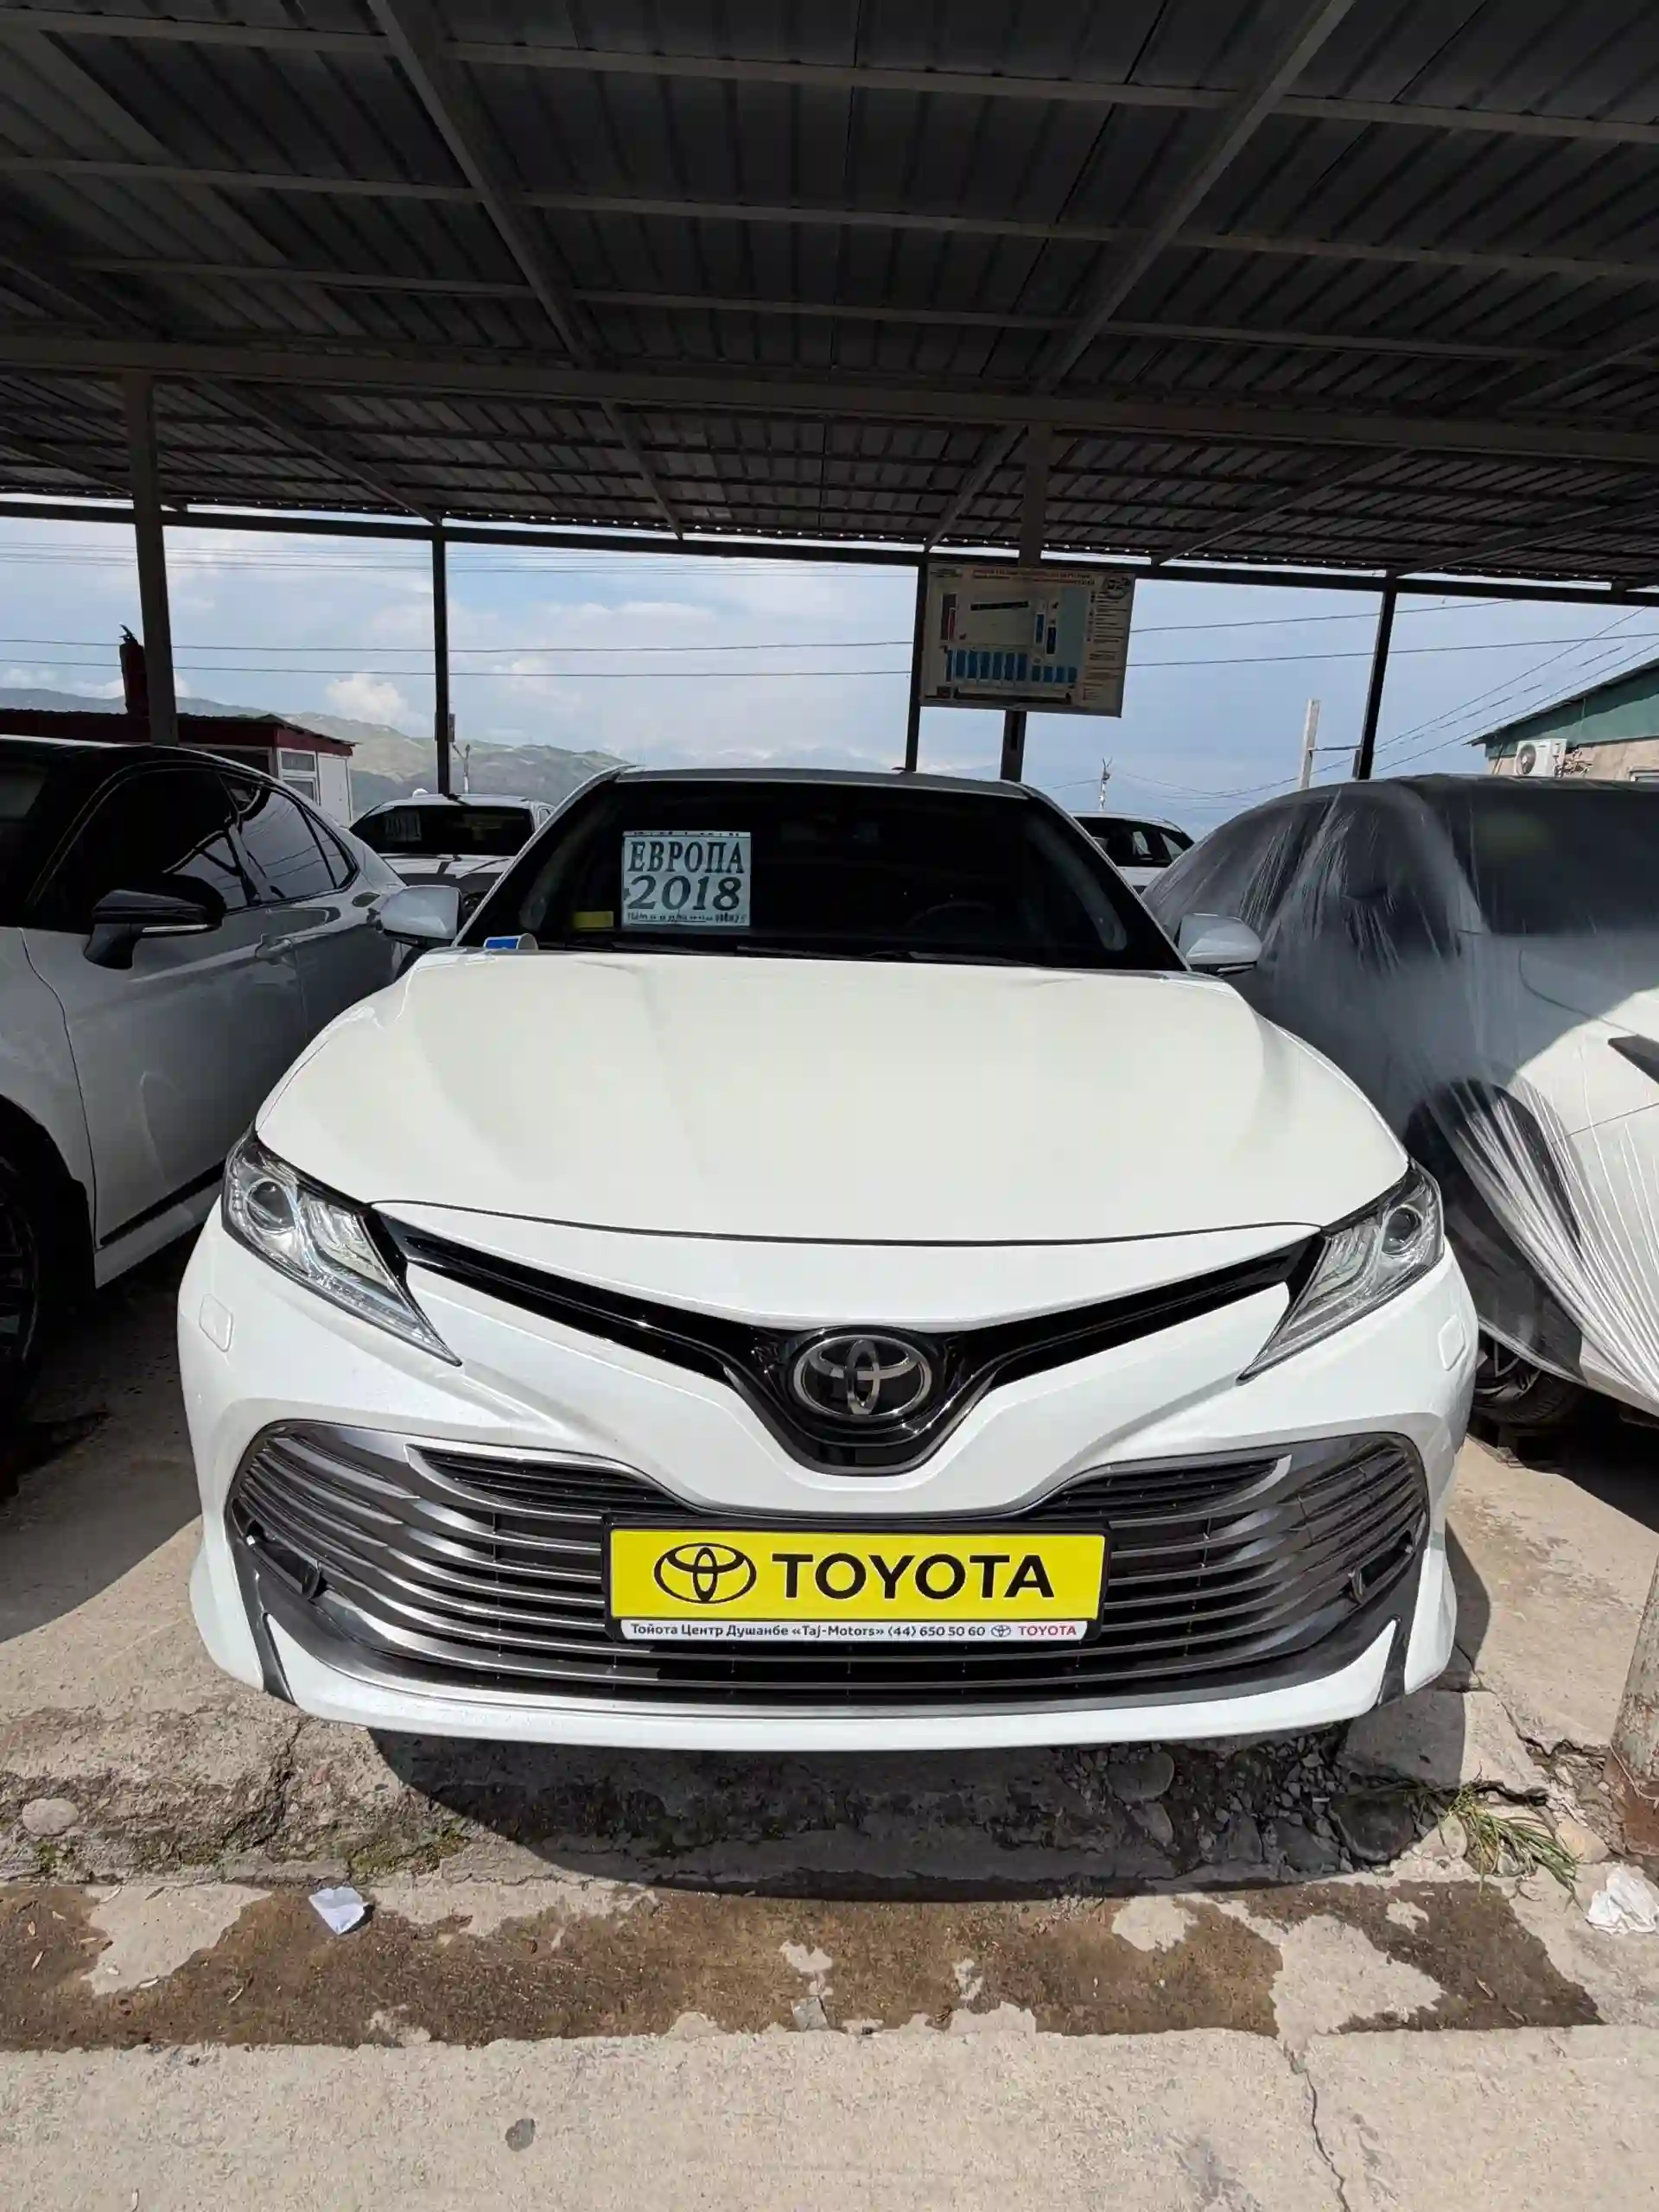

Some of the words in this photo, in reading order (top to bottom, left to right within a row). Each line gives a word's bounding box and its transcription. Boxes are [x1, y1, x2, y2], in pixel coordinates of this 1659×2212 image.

[626, 841, 745, 874] ЕВРОПА
[626, 875, 741, 911] 2018
[772, 1552, 1055, 1600] TOYOTA
[631, 1623, 677, 1635] Тойота
[681, 1624, 723, 1637] Центр
[726, 1624, 788, 1637] Душанбе
[791, 1624, 884, 1638] «Taj-Motors»
[887, 1625, 916, 1637] (44)
[919, 1626, 945, 1637] 650
[948, 1626, 965, 1637] 50
[968, 1626, 985, 1637] 60
[1018, 1625, 1077, 1637] TOYOTA
